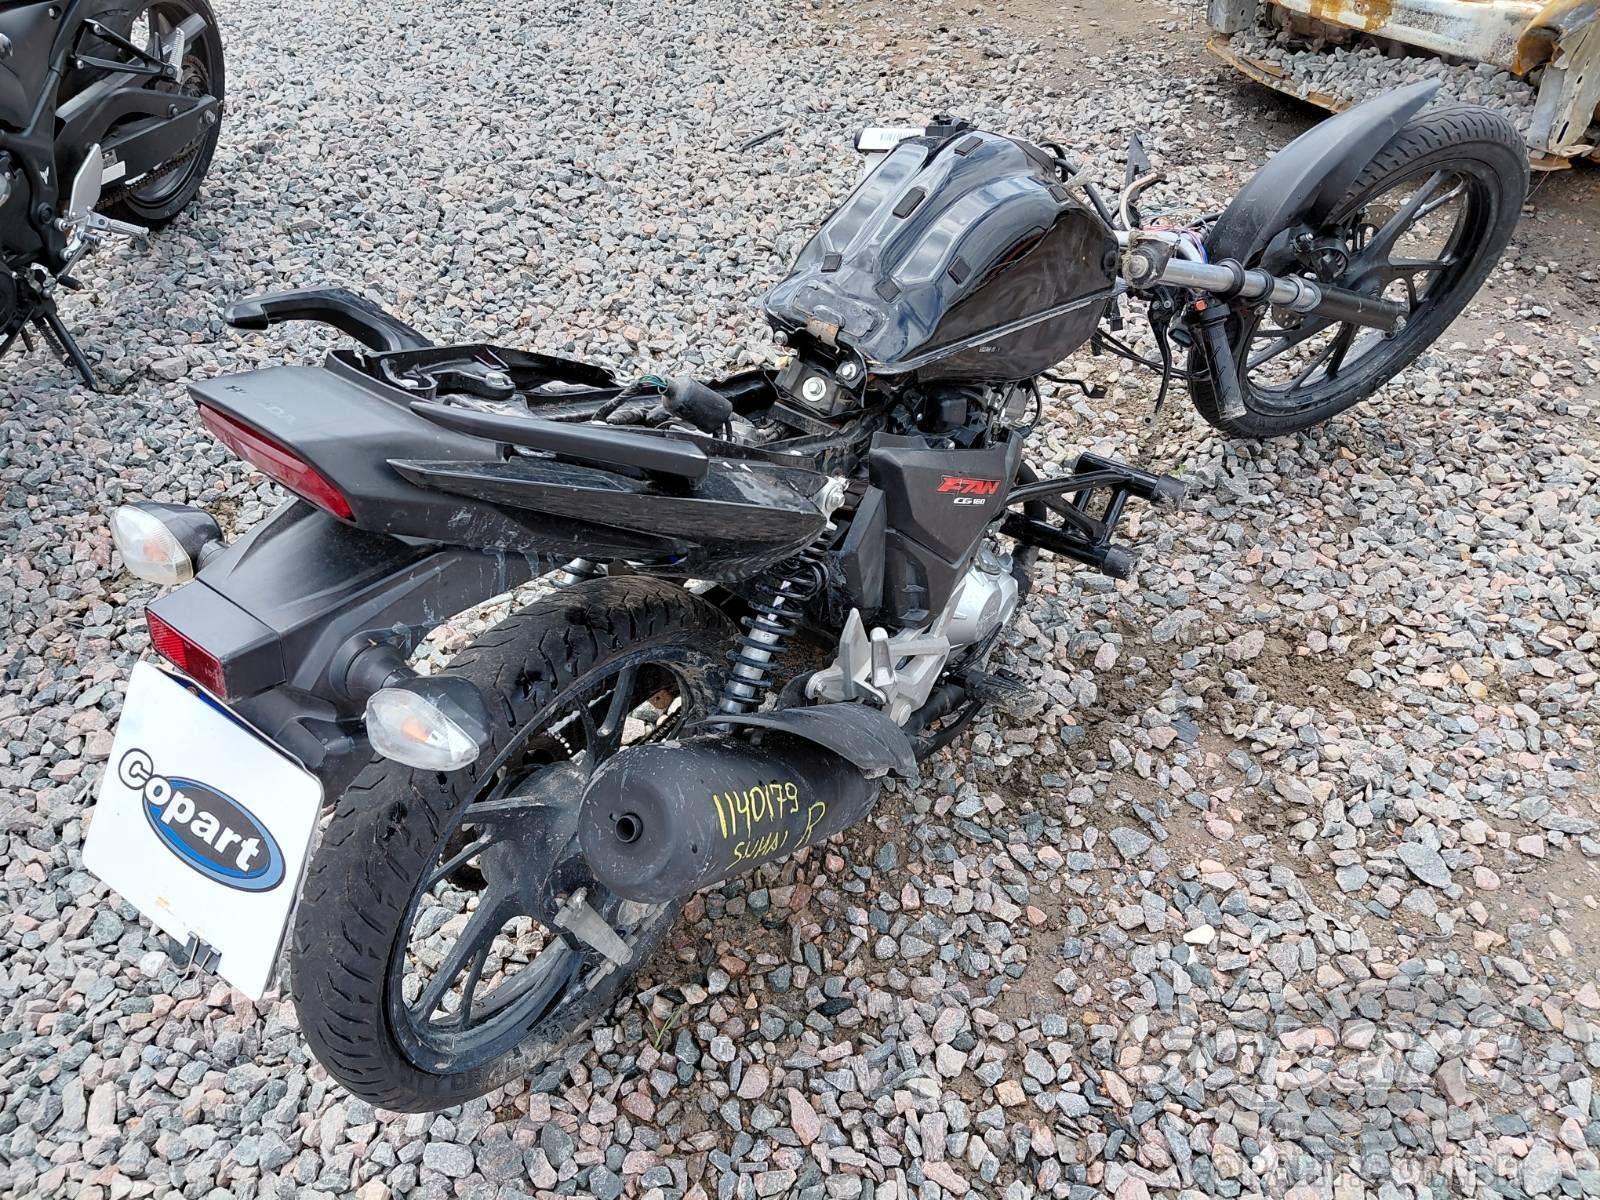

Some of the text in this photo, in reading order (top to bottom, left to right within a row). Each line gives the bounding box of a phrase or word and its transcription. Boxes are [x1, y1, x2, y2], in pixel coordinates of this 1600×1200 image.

[953, 497, 973, 505] CG
[118, 748, 260, 872] Copart
[713, 782, 799, 839] 1140179
